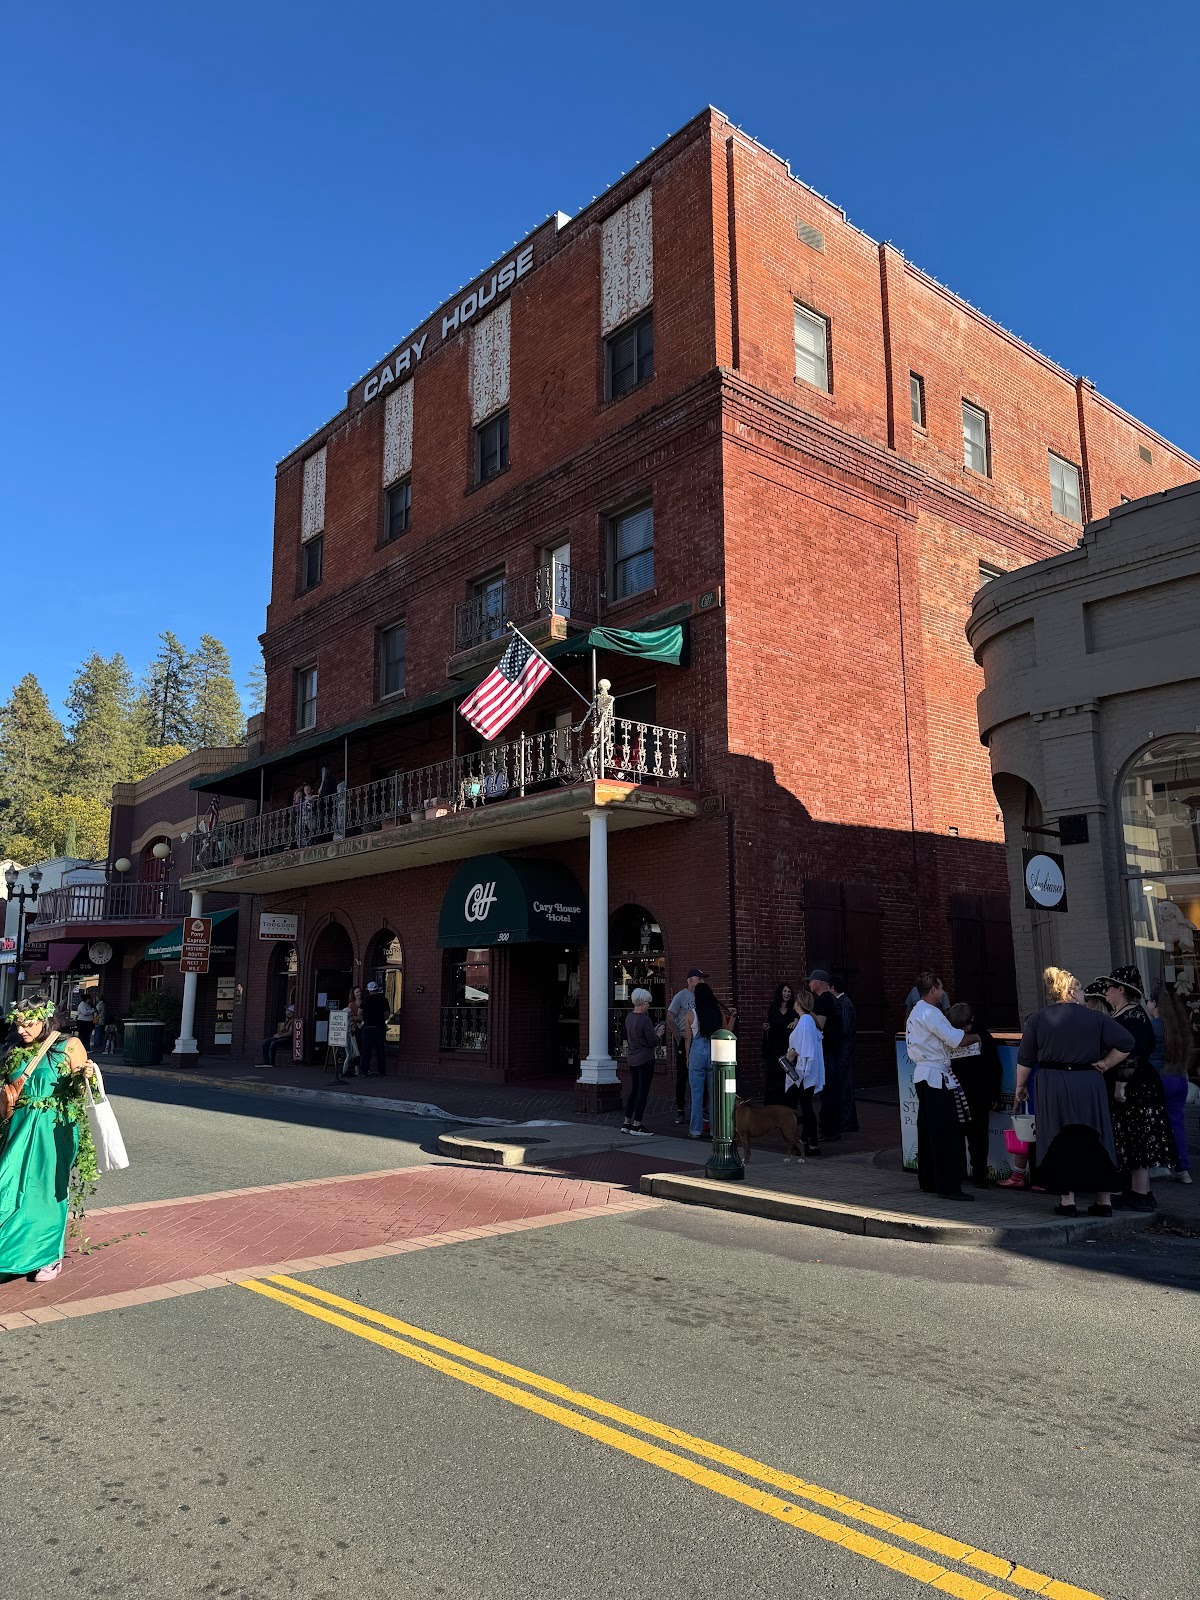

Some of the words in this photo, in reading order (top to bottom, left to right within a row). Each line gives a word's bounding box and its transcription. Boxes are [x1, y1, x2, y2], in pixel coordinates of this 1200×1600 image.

[364, 333, 429, 403] CARY
[442, 244, 534, 340] HOUSE
[339, 839, 366, 854] HOUSE
[533, 901, 553, 914] Cary
[554, 903, 582, 914] House
[546, 914, 571, 923] Hotel
[639, 976, 653, 987] Cary
